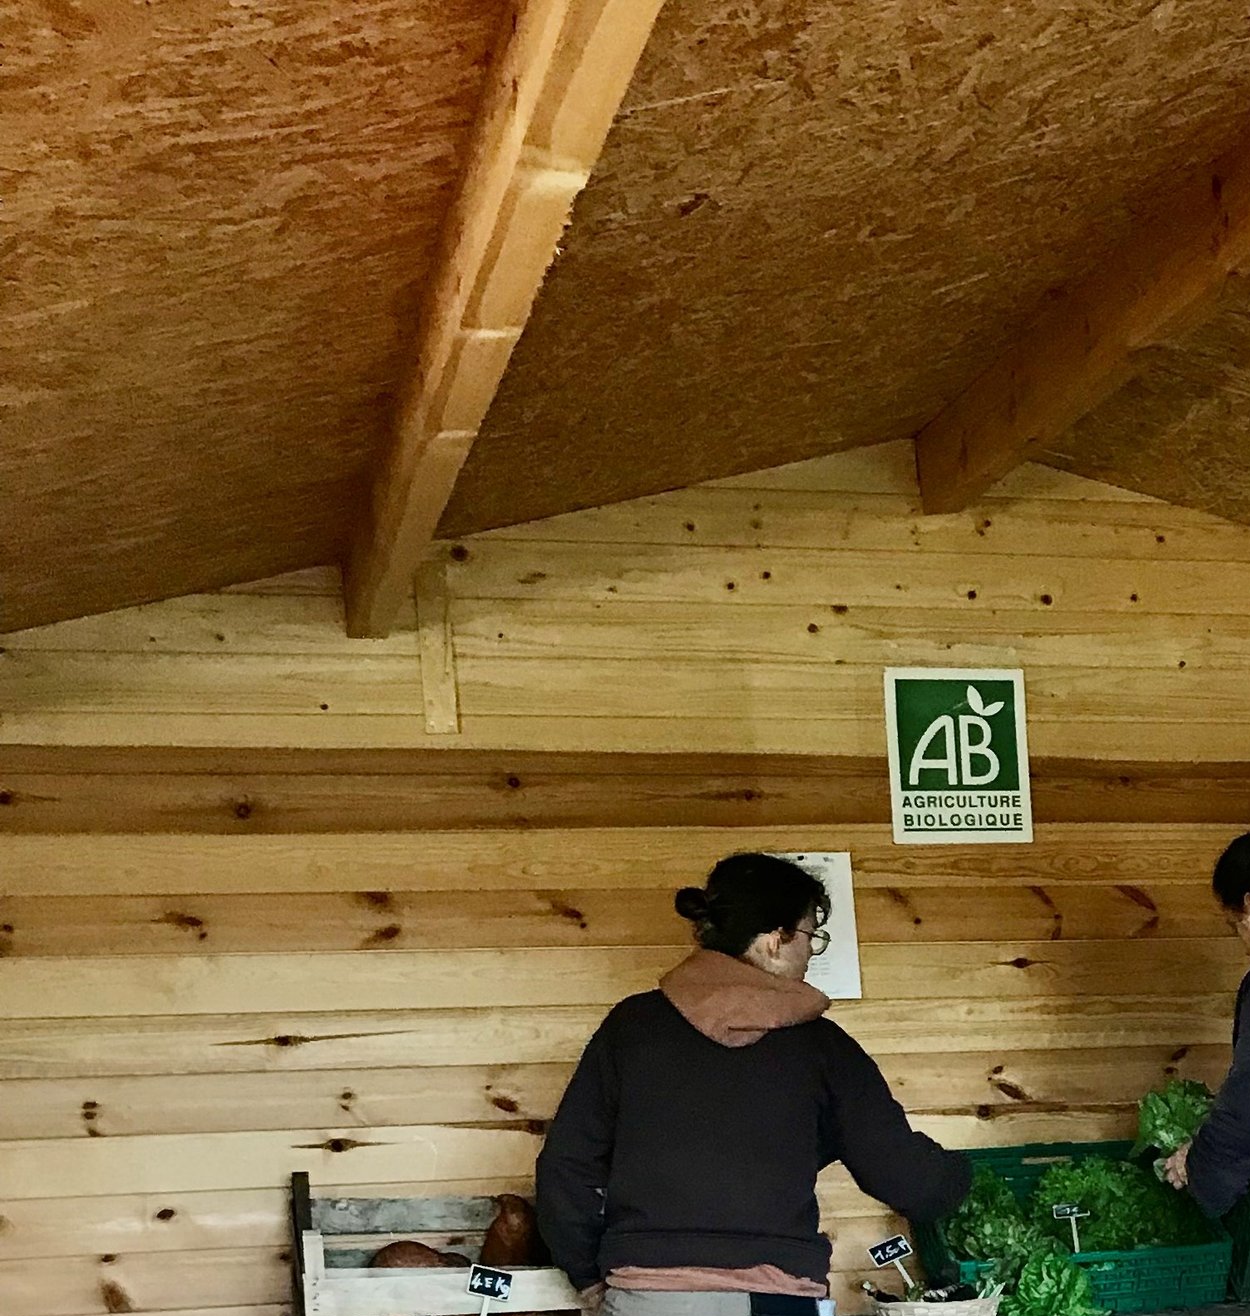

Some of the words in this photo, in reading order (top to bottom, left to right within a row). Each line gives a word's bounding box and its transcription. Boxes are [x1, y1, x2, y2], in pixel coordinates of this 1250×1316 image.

[909, 715, 1000, 786] AB
[902, 795, 1022, 808] AGRICULTURE
[904, 813, 1023, 827] BIOLOGIQUE
